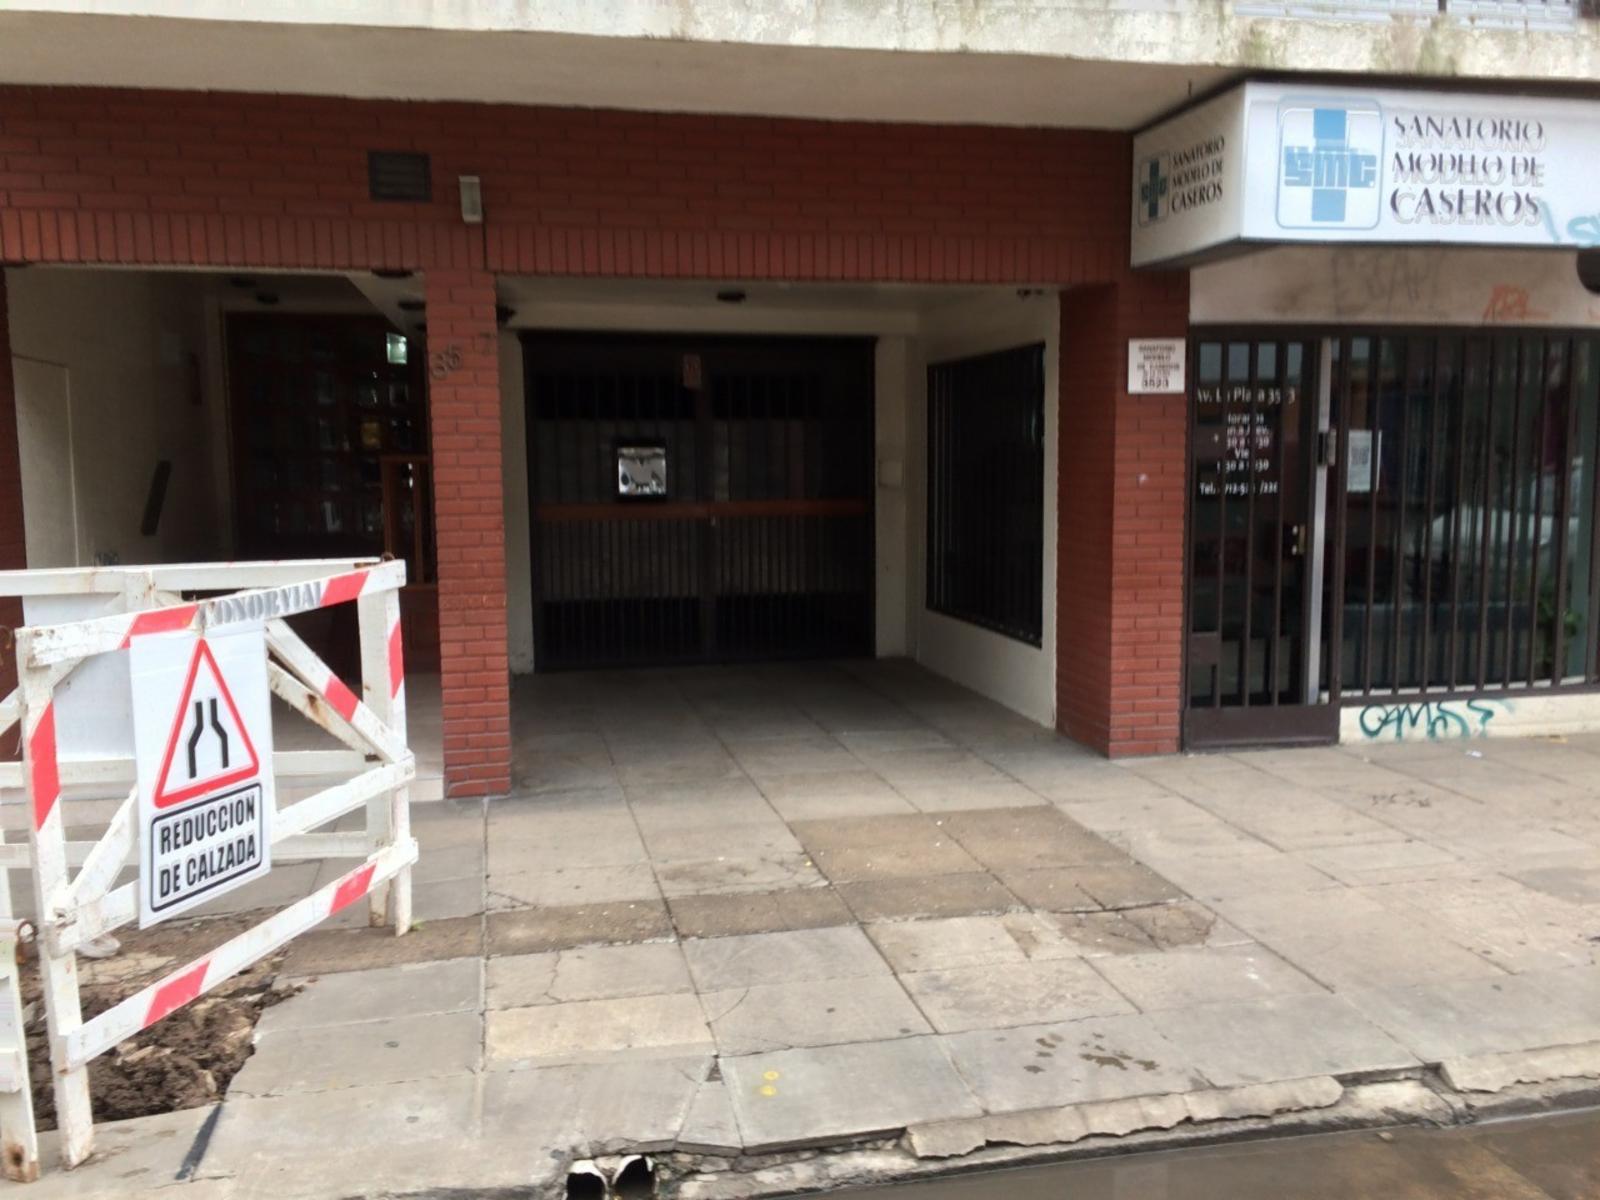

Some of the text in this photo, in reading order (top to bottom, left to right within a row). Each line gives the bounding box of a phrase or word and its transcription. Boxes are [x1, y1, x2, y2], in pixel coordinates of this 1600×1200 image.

[1394, 115, 1545, 147] SANATORIO
[1173, 135, 1225, 167] SANATORIO
[1393, 152, 1541, 183] MODELO DE
[1172, 182, 1223, 214] CASEROS
[1390, 187, 1541, 221] CASEROS
[1233, 386, 1265, 402] Plaa
[1268, 387, 1295, 405] 353
[160, 795, 256, 855] REDUCCION
[160, 833, 256, 898] DE CALZADA
